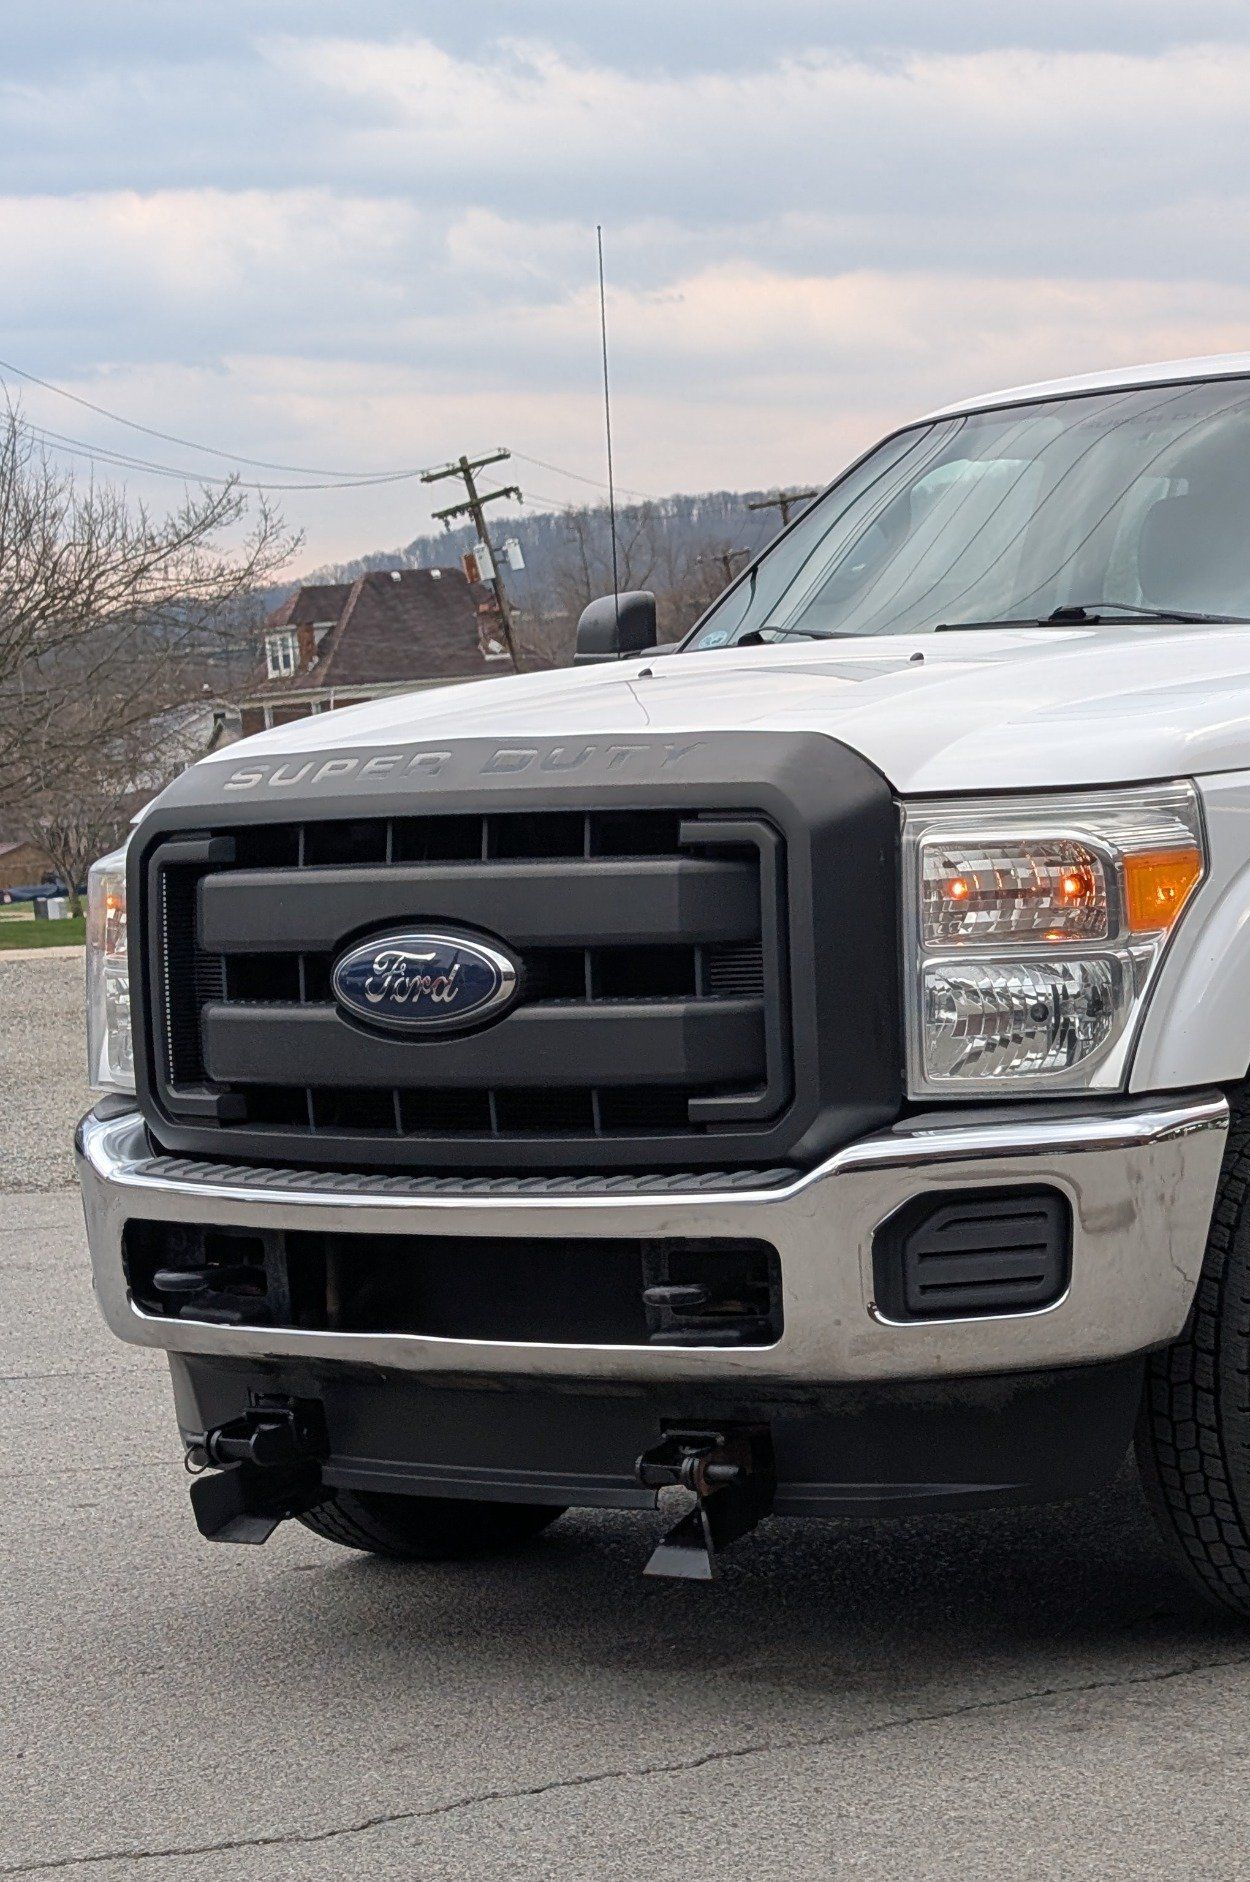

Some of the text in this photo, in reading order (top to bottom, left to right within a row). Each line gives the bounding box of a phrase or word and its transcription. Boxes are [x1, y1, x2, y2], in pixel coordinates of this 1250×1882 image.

[224, 743, 708, 790] SUPER DUTY
[364, 950, 461, 1003] Ford
